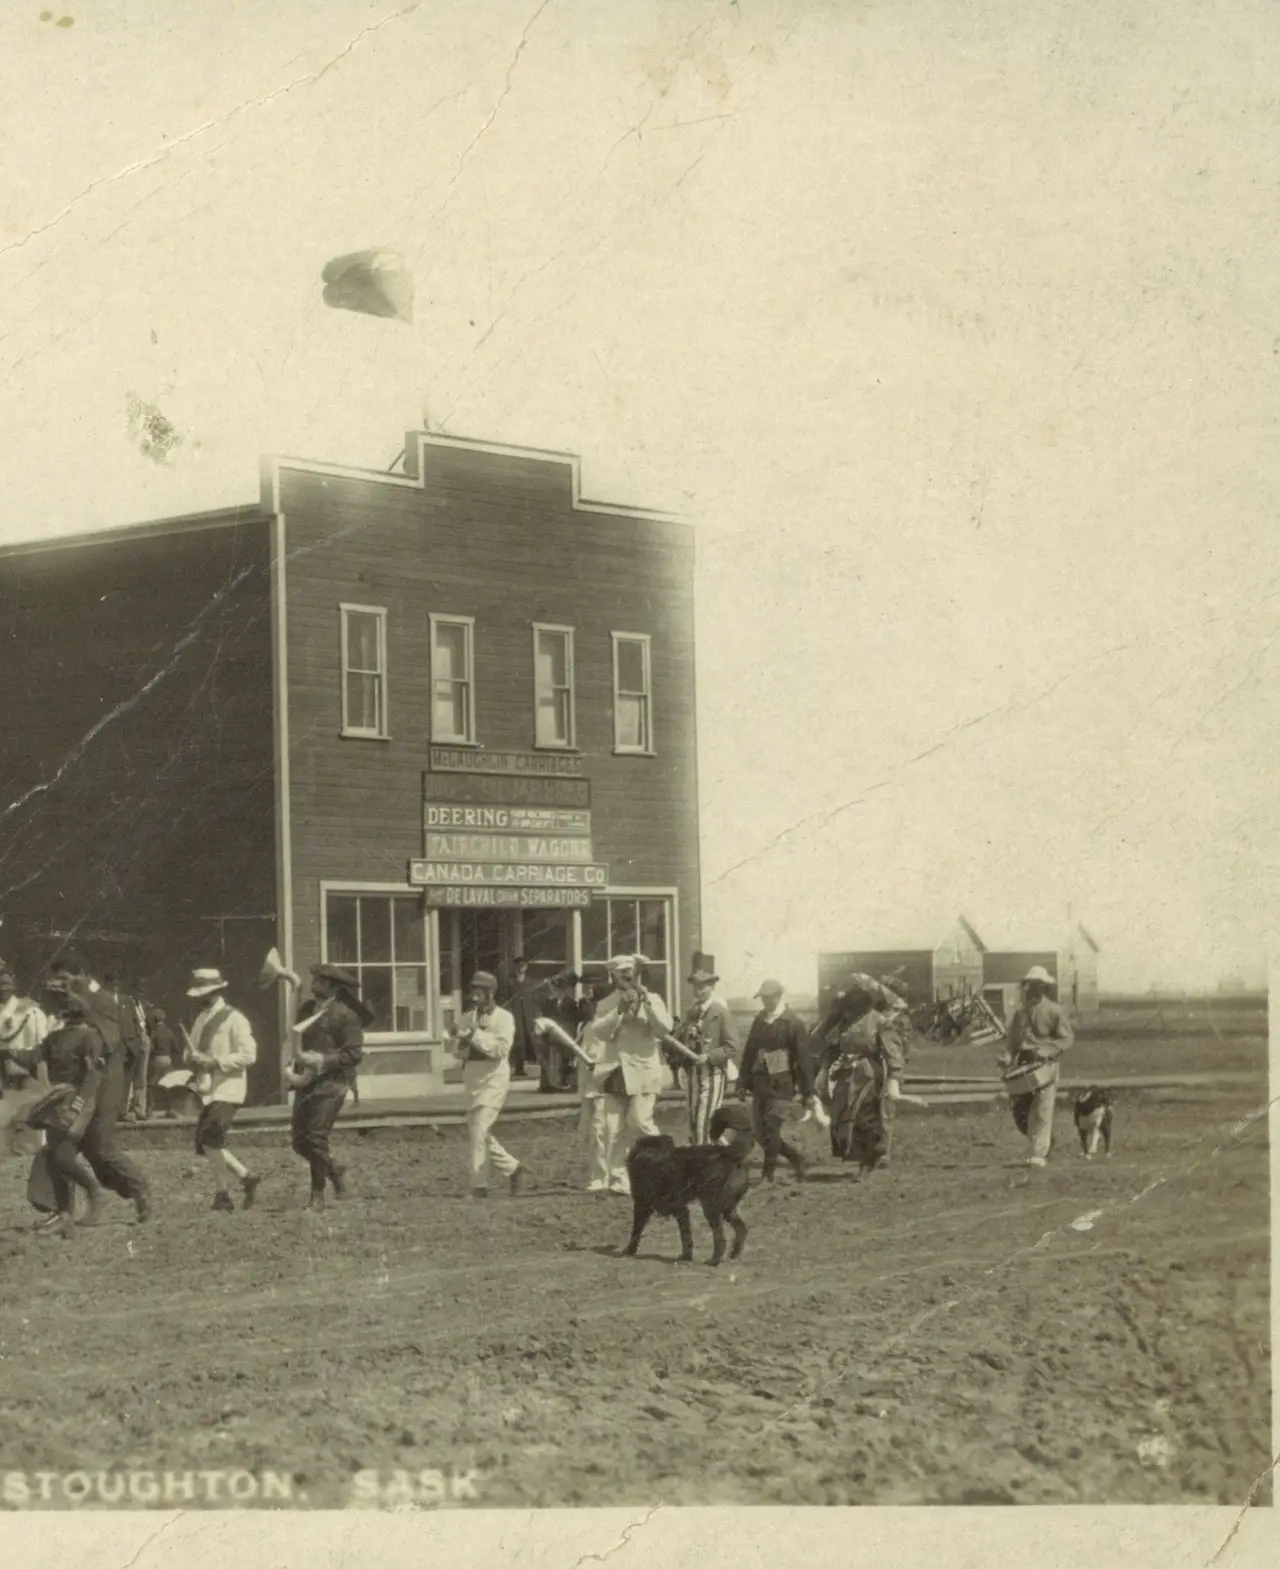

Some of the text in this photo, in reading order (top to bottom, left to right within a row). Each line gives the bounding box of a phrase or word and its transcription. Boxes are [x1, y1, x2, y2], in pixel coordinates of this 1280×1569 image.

[427, 807, 508, 827] DEERING
[412, 863, 484, 882] CANADA
[493, 864, 577, 882] CARRIAGE
[446, 887, 461, 904] DE
[463, 887, 496, 905] LAVAL
[520, 888, 589, 906] SEPARATORS
